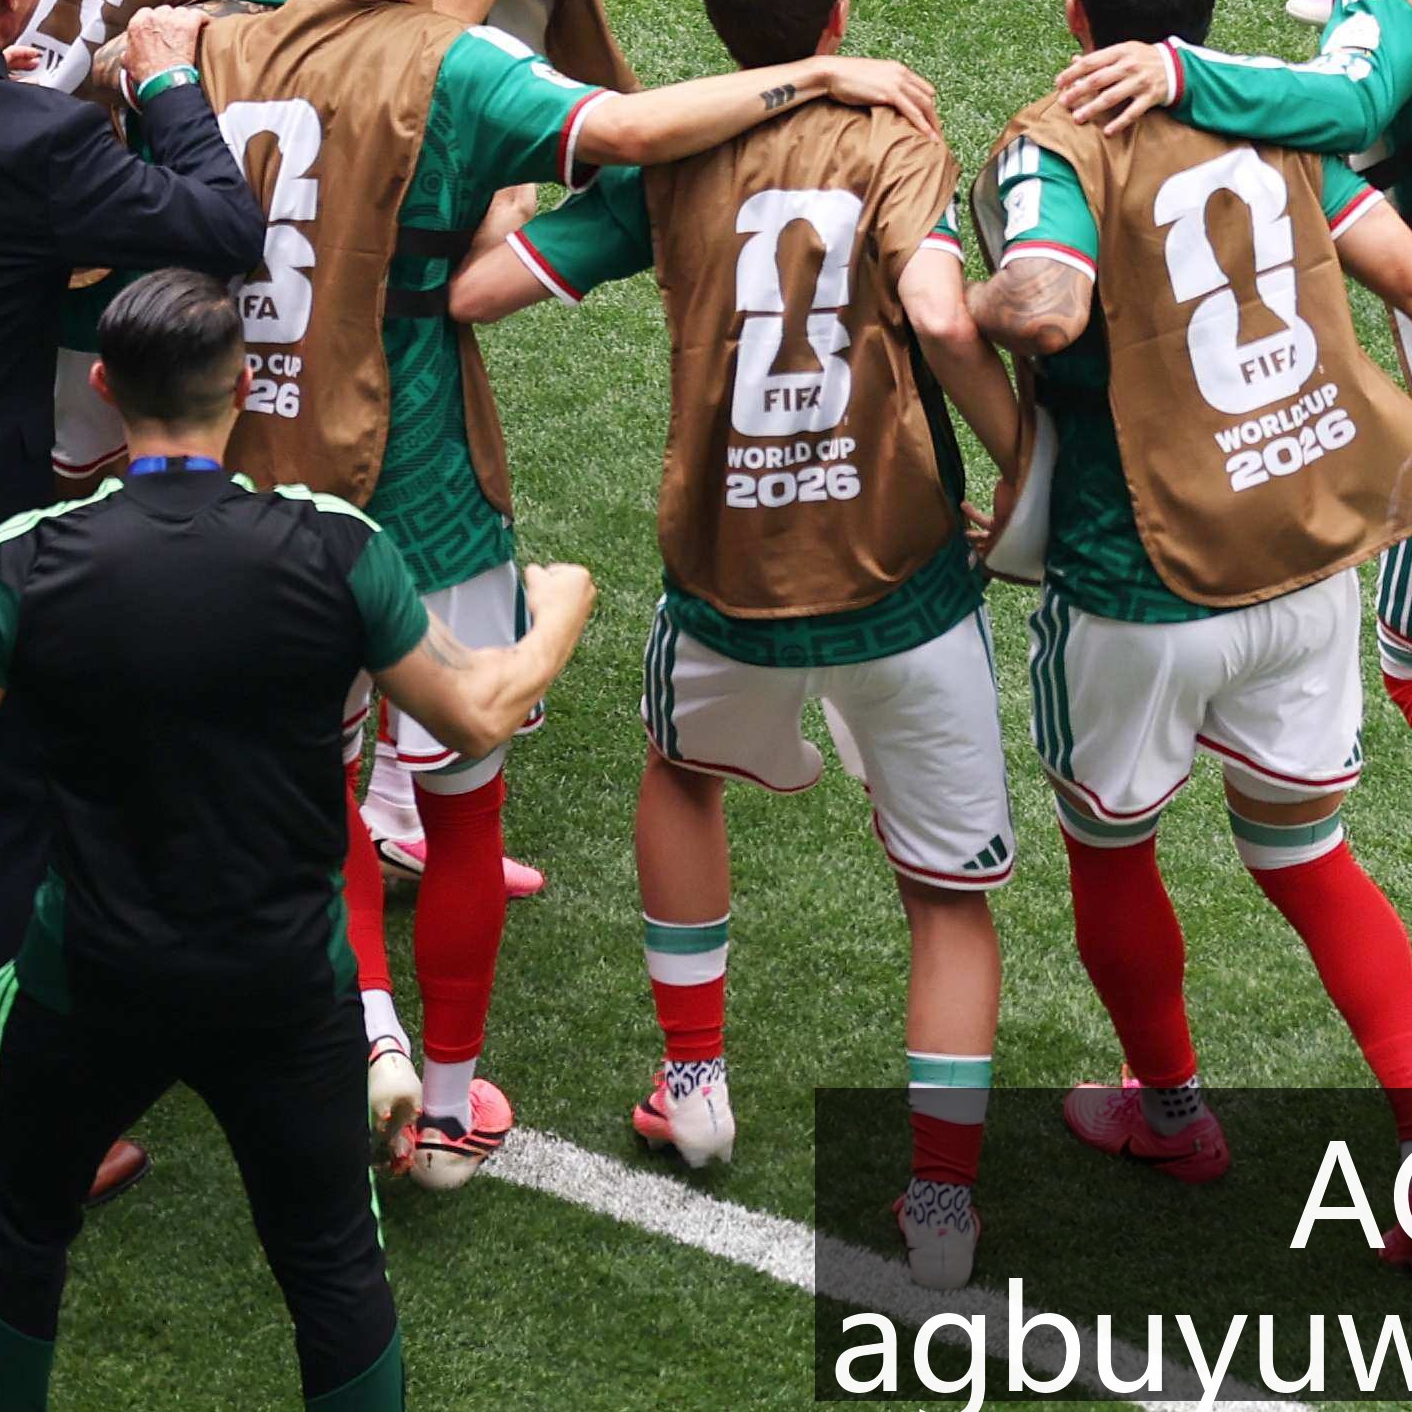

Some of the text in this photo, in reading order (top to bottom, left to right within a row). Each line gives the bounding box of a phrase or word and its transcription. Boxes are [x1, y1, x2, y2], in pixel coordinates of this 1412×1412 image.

[243, 295, 280, 320] FA
[245, 379, 300, 418] 26
[764, 386, 823, 413] FIFA
[1214, 404, 1304, 453] WORLD
[727, 437, 856, 469] WORLD CUP
[1226, 409, 1356, 492] 2026
[725, 463, 861, 508] 2026
